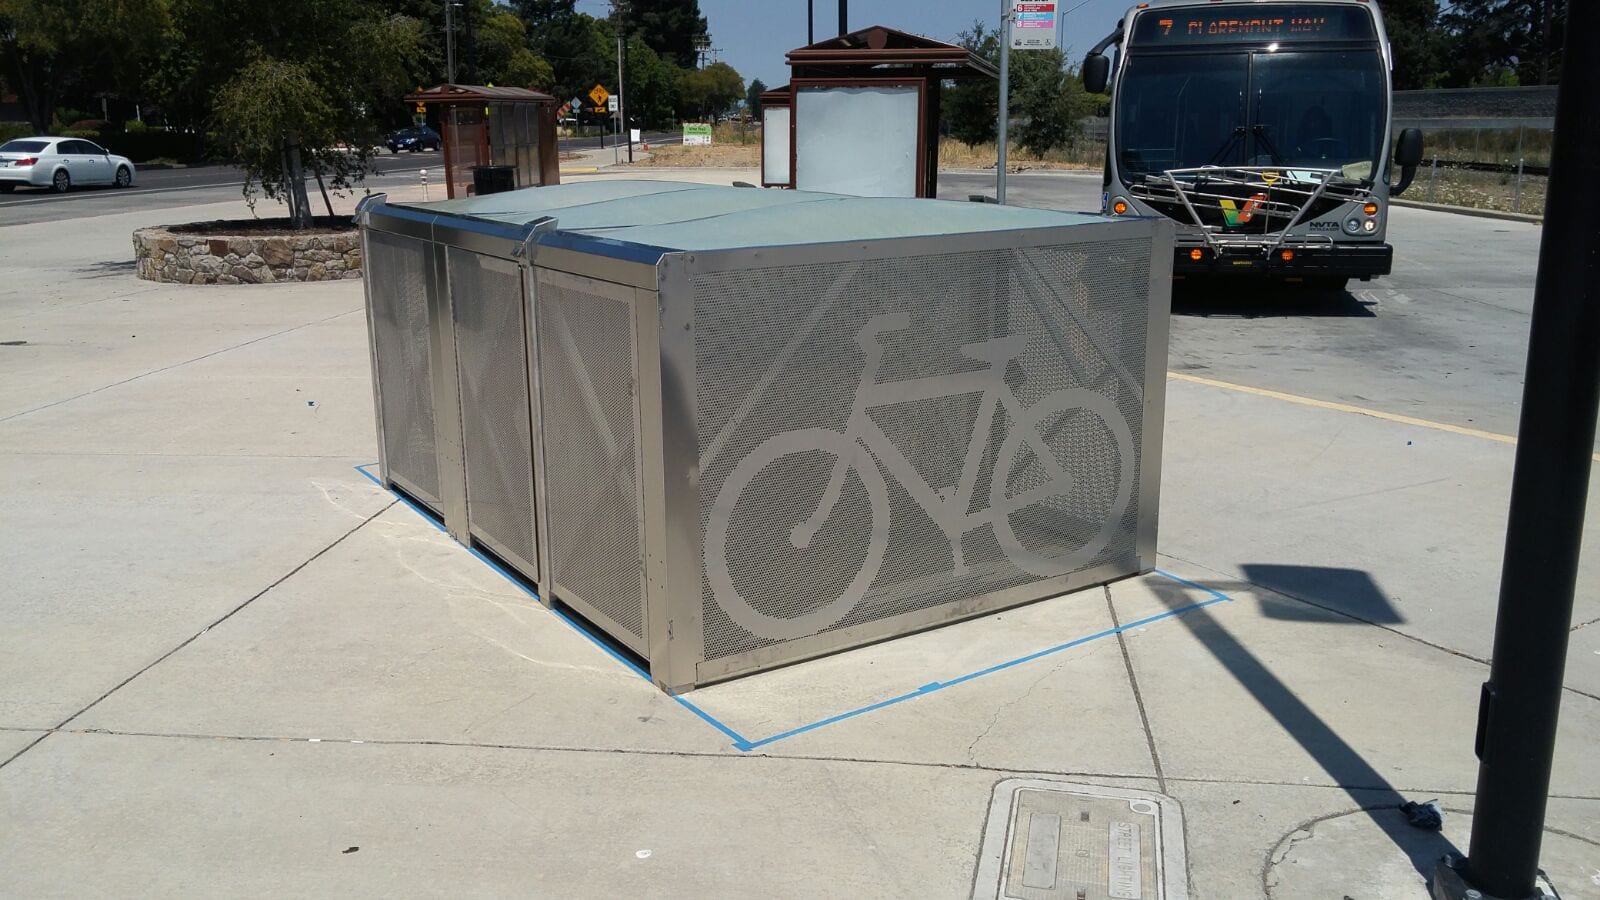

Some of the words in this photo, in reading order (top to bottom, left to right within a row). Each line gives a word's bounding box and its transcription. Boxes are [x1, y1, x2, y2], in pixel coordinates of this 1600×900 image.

[1159, 19, 1174, 36] 7
[1118, 822, 1132, 851] STREET
[1116, 856, 1133, 897] LIGHTING
